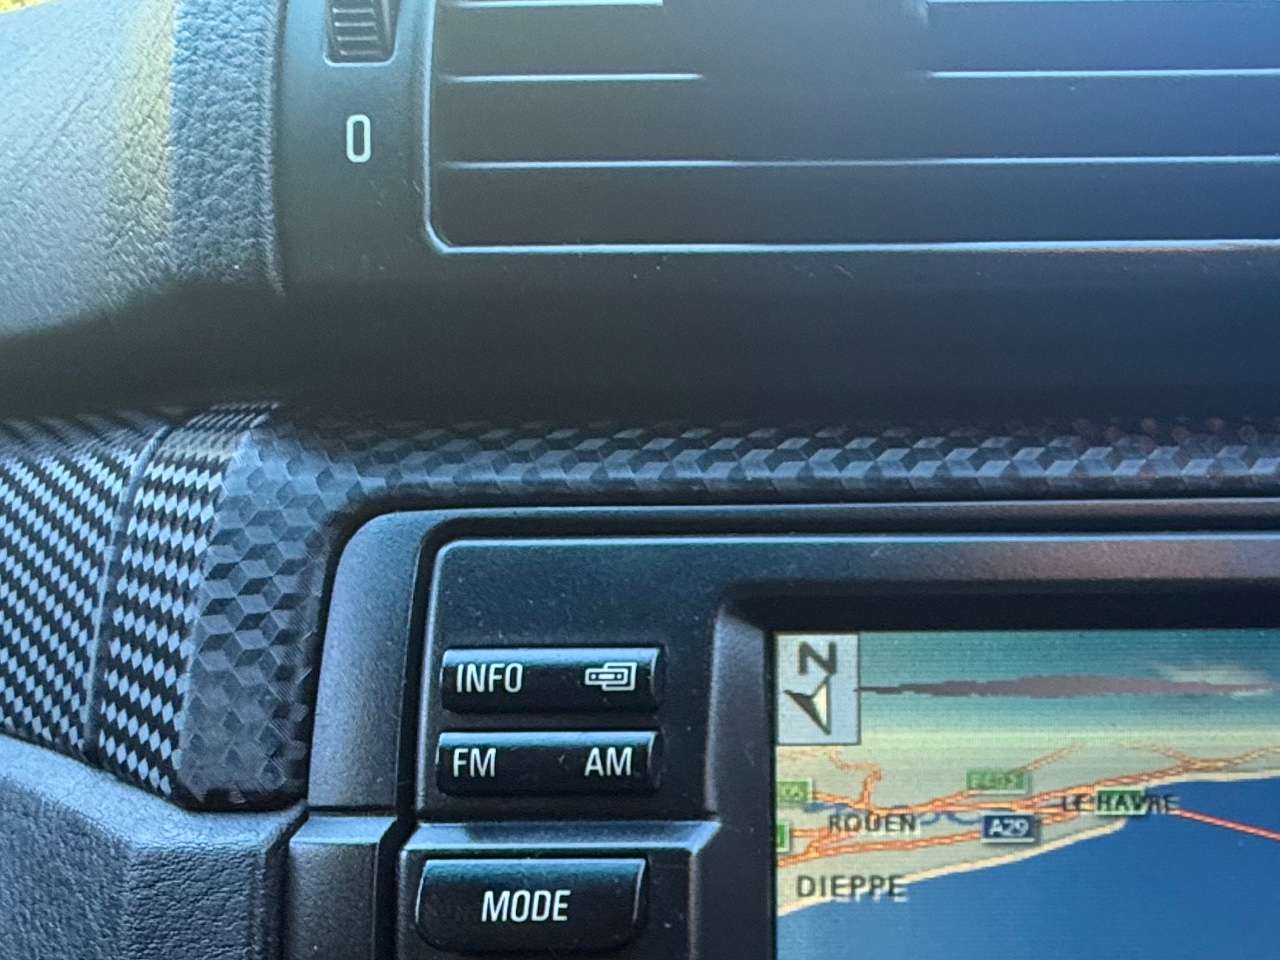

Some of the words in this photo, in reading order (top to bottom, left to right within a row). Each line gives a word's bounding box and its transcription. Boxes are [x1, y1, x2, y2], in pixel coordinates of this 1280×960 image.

[456, 663, 523, 693] INFO
[453, 748, 497, 777] FM
[584, 747, 633, 776] AM
[828, 813, 917, 834] ROUEN
[987, 820, 1030, 838] A29
[797, 874, 907, 898] DIEPPE
[481, 890, 571, 922] MODE
